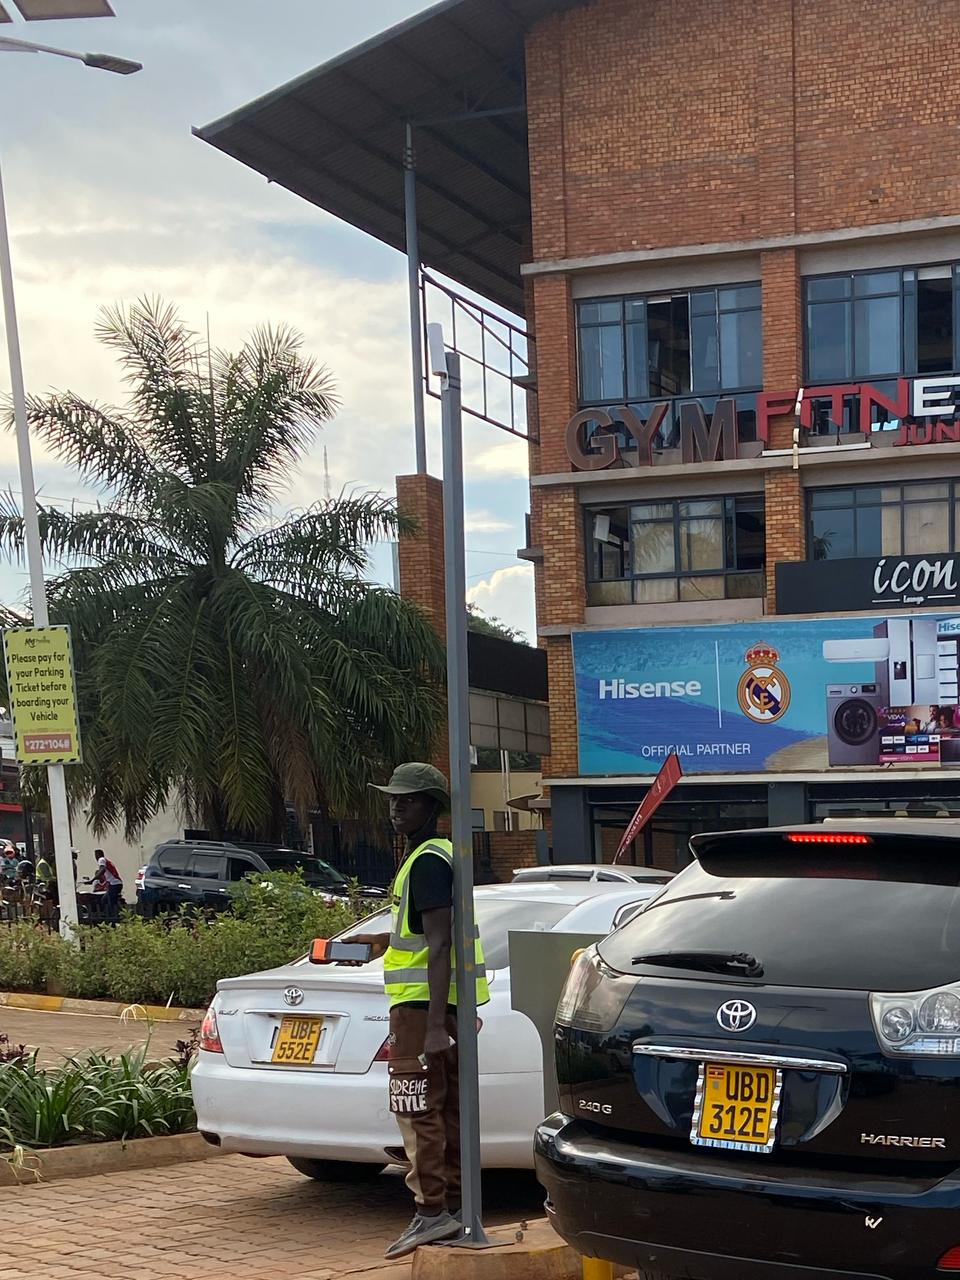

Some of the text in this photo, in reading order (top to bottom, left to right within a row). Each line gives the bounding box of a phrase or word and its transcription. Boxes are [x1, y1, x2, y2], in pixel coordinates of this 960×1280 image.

[565, 398, 739, 471] GYM
[873, 560, 958, 593] icon
[11, 652, 66, 665] Please pay for
[16, 667, 65, 681] your Parking
[16, 681, 67, 693] Ticket before
[599, 678, 702, 700] Hisense
[16, 697, 69, 709] boarding your
[30, 711, 59, 722] Vehicle
[641, 743, 751, 758] OFFICIAL PARTNER
[290, 1019, 319, 1040] UBF
[276, 1041, 314, 1061] 552E
[725, 1071, 769, 1103] UBD
[390, 1095, 428, 1112] STYLE
[709, 1103, 767, 1138] 312E
[860, 1132, 946, 1148] HARRIER
